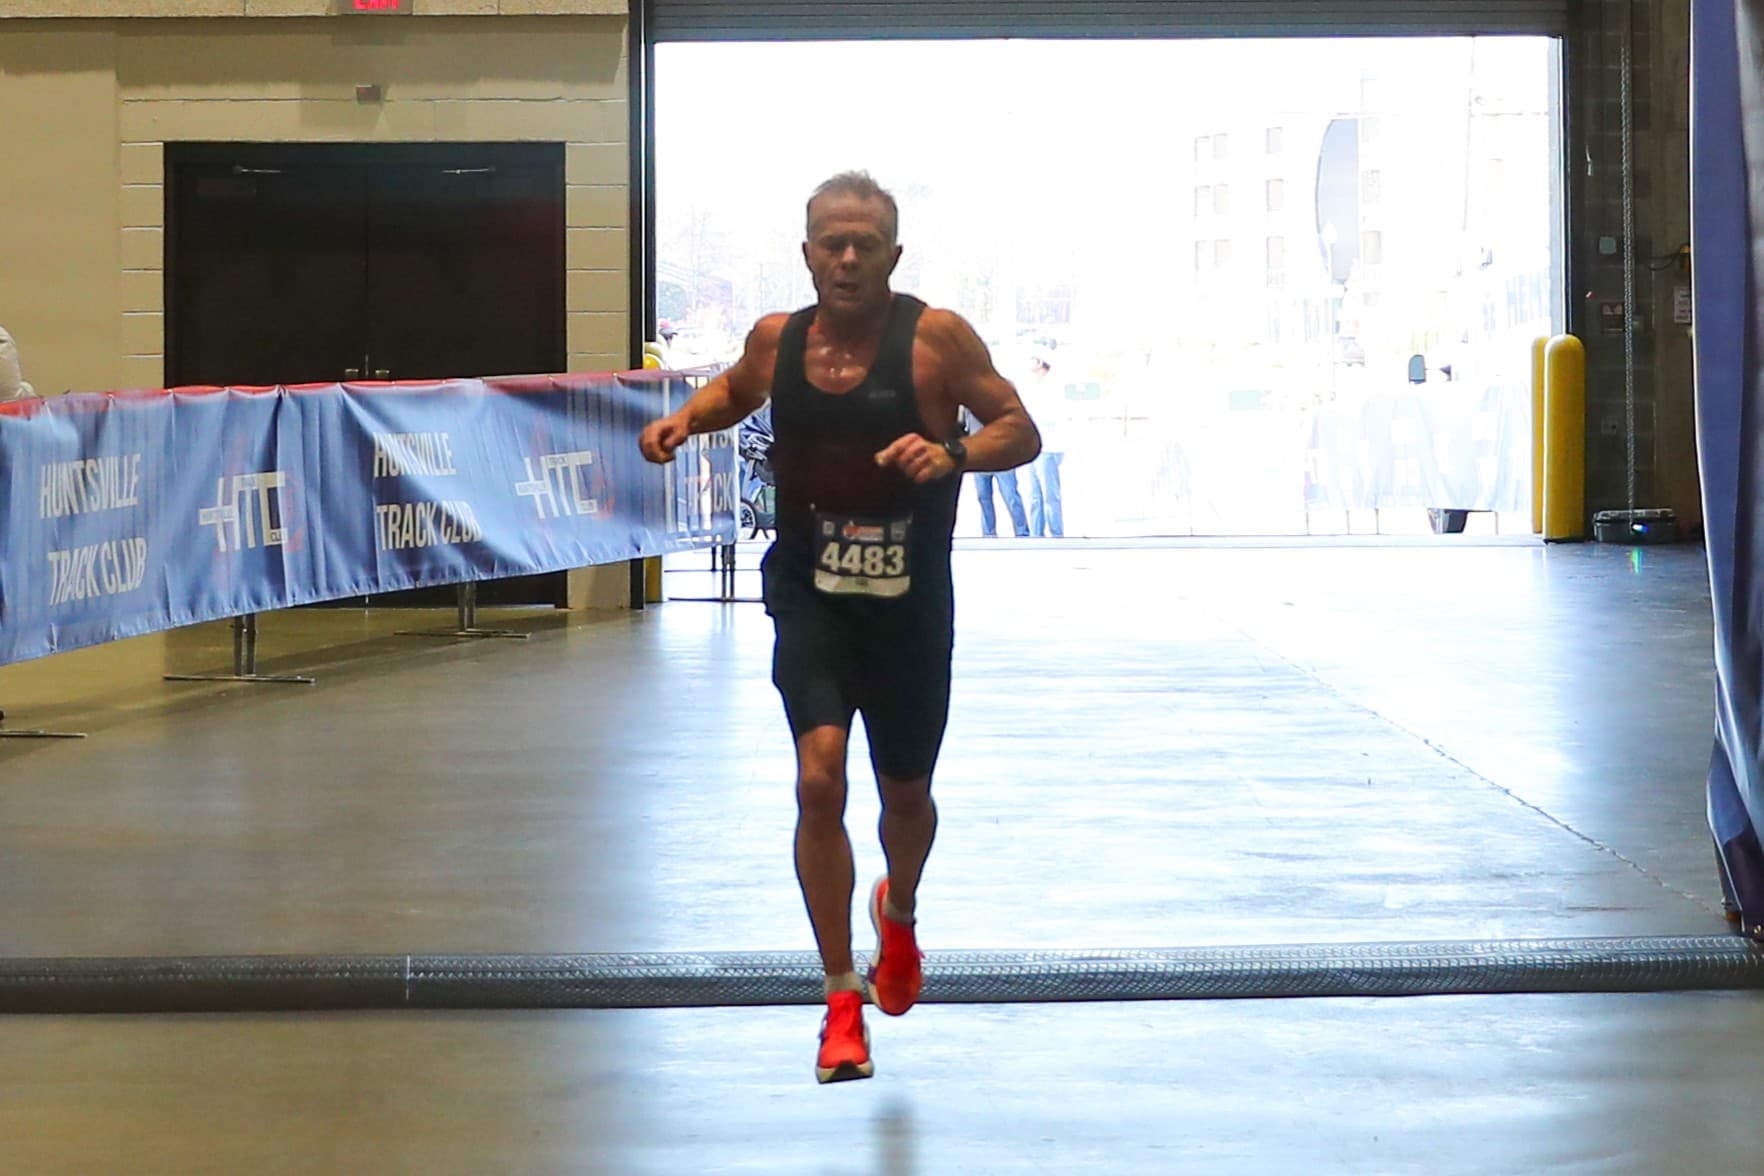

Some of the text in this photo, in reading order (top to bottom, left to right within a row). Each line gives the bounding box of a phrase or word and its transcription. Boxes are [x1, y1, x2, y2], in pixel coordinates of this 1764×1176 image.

[372, 431, 457, 478] HUNTSVILLE
[39, 453, 141, 519] HUNTSVILLE
[375, 500, 482, 551] TRACK CLUB
[48, 537, 147, 606] TRACK CLUB
[821, 541, 905, 576] 4483
